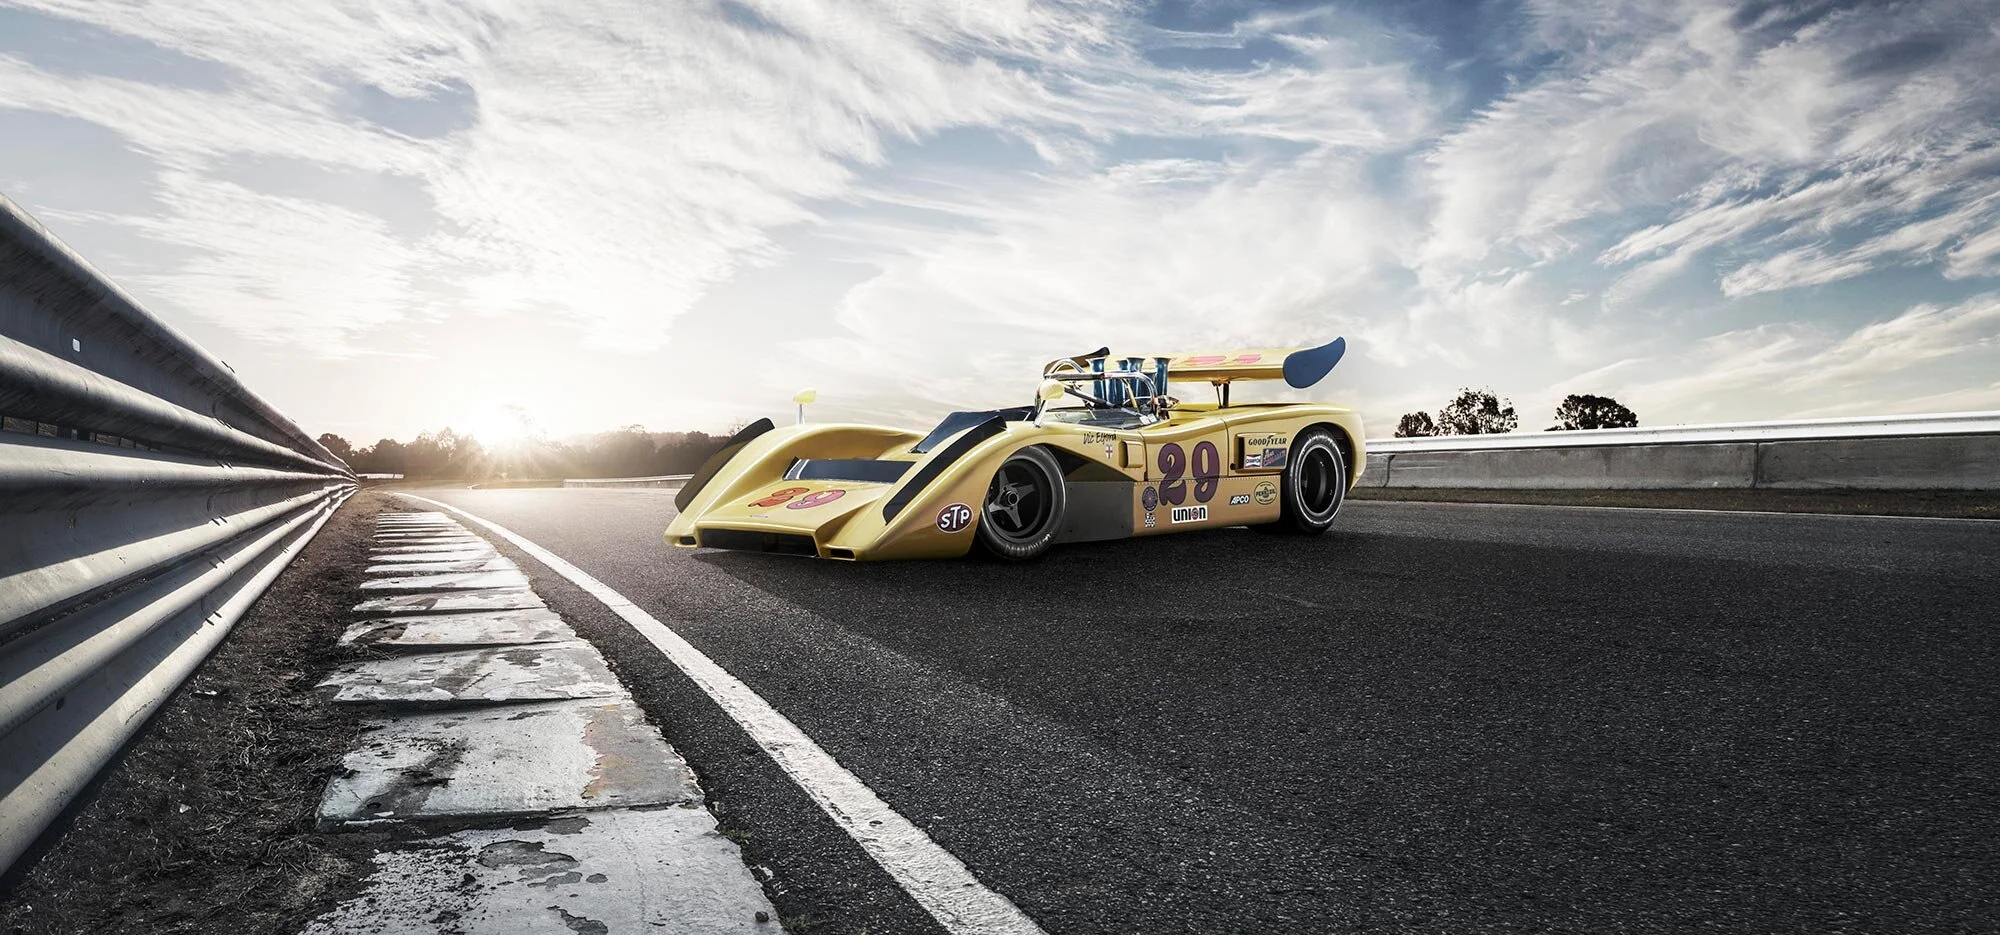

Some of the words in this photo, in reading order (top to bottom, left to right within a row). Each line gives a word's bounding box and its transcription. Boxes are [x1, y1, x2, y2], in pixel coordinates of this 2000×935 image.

[1248, 435, 1287, 446] GOODYEAR
[1158, 440, 1220, 506] 29
[748, 487, 846, 510] 29
[1230, 495, 1250, 505] APCO
[940, 505, 970, 529] STP
